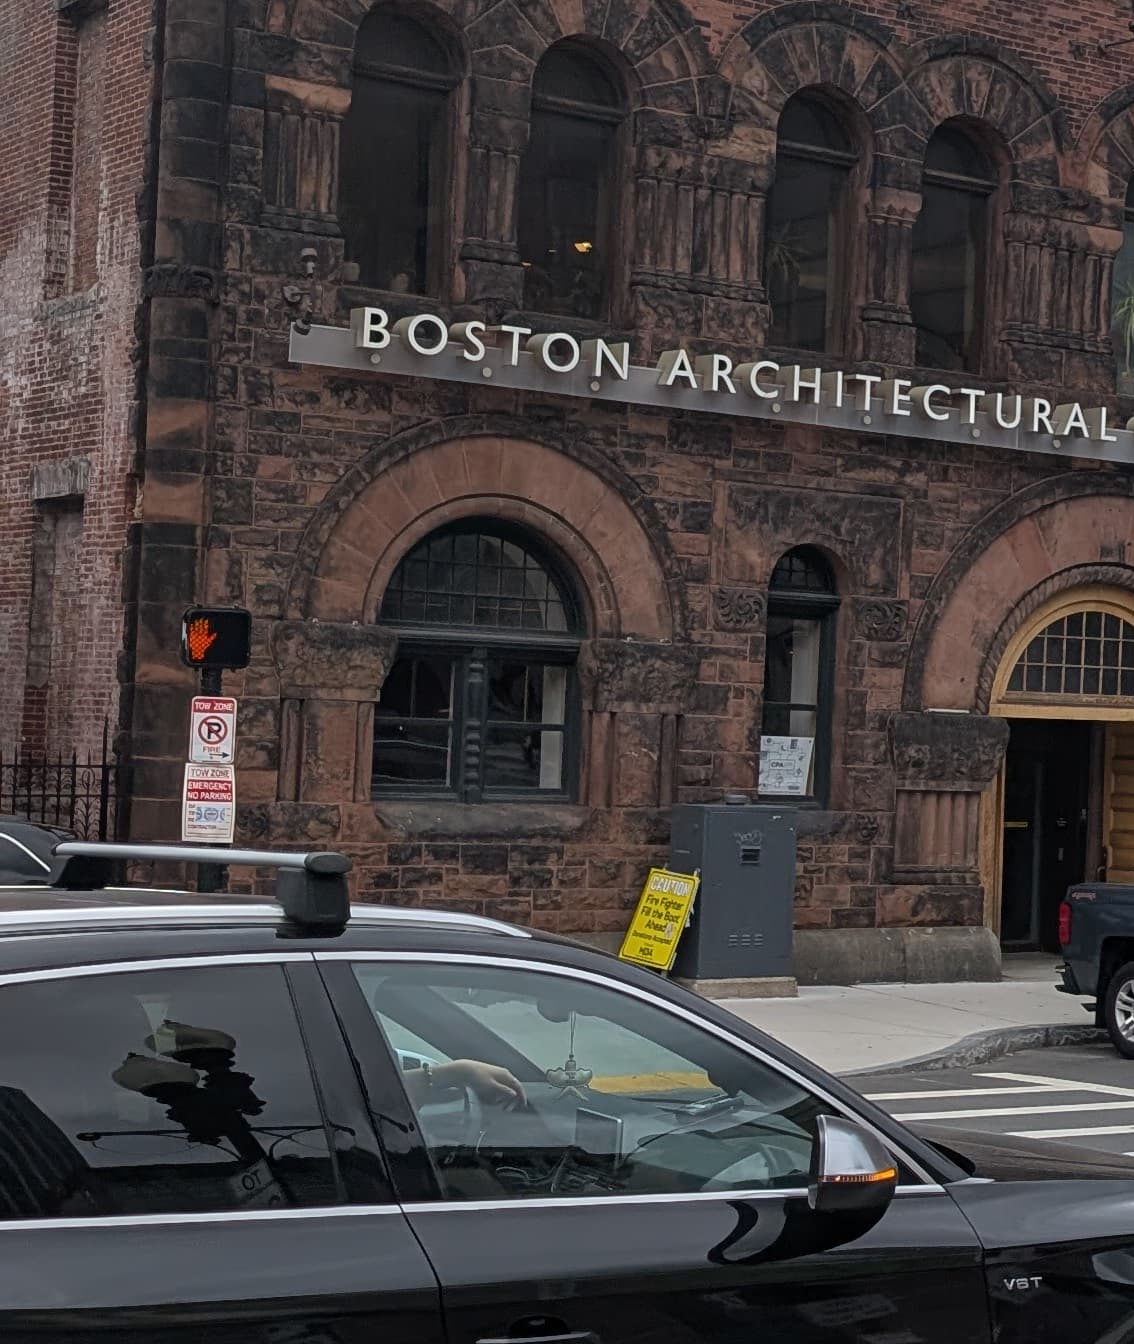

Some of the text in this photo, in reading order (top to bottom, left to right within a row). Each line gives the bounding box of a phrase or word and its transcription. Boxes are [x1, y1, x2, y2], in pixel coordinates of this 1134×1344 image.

[356, 306, 630, 381] BOSTON
[662, 348, 1117, 443] ARCHITECTURAL
[195, 701, 234, 711] TOW ZONE
[191, 768, 229, 778] TOW ZONE
[188, 781, 232, 791] EMERGENCY
[187, 791, 232, 801] NO PARKING
[650, 876, 690, 897] CAUTION
[645, 894, 660, 904] Fire
